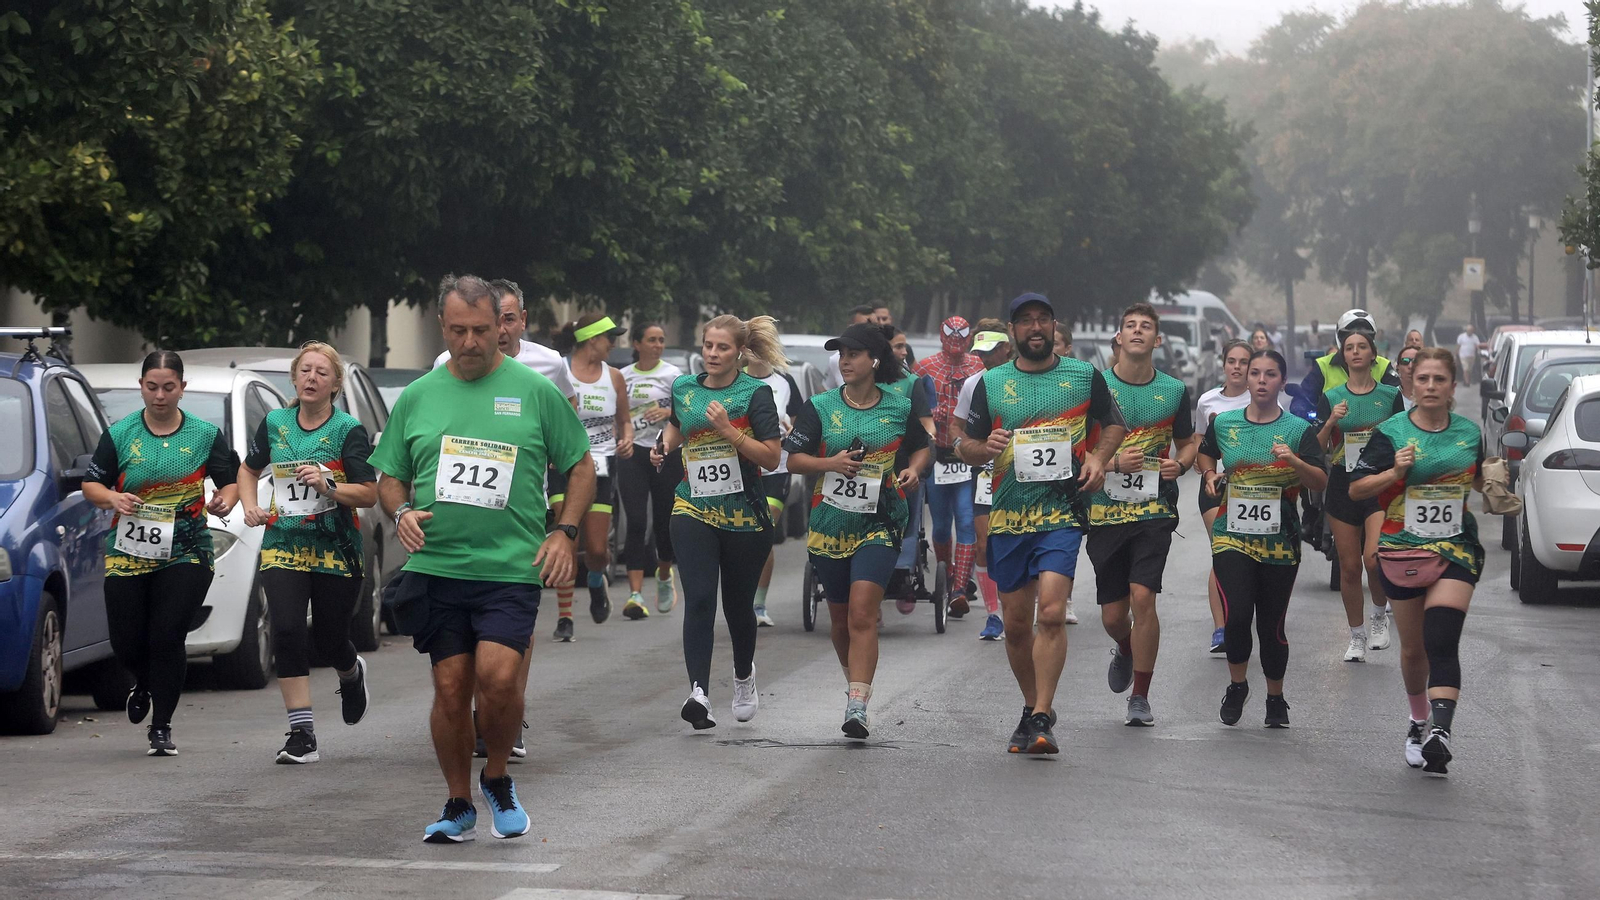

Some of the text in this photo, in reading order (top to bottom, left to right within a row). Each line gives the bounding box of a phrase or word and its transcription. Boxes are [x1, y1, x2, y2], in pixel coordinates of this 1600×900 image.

[451, 438, 479, 446] CARRERA
[480, 442, 513, 452] SOLIDARIA
[1032, 448, 1056, 467] 32
[450, 462, 499, 490] 212
[698, 464, 730, 482] 439
[942, 463, 967, 474] 200
[833, 478, 868, 500] 281
[1122, 473, 1144, 490] 34
[1237, 504, 1271, 521] 246
[1416, 505, 1452, 523] 326
[125, 521, 162, 544] 218
